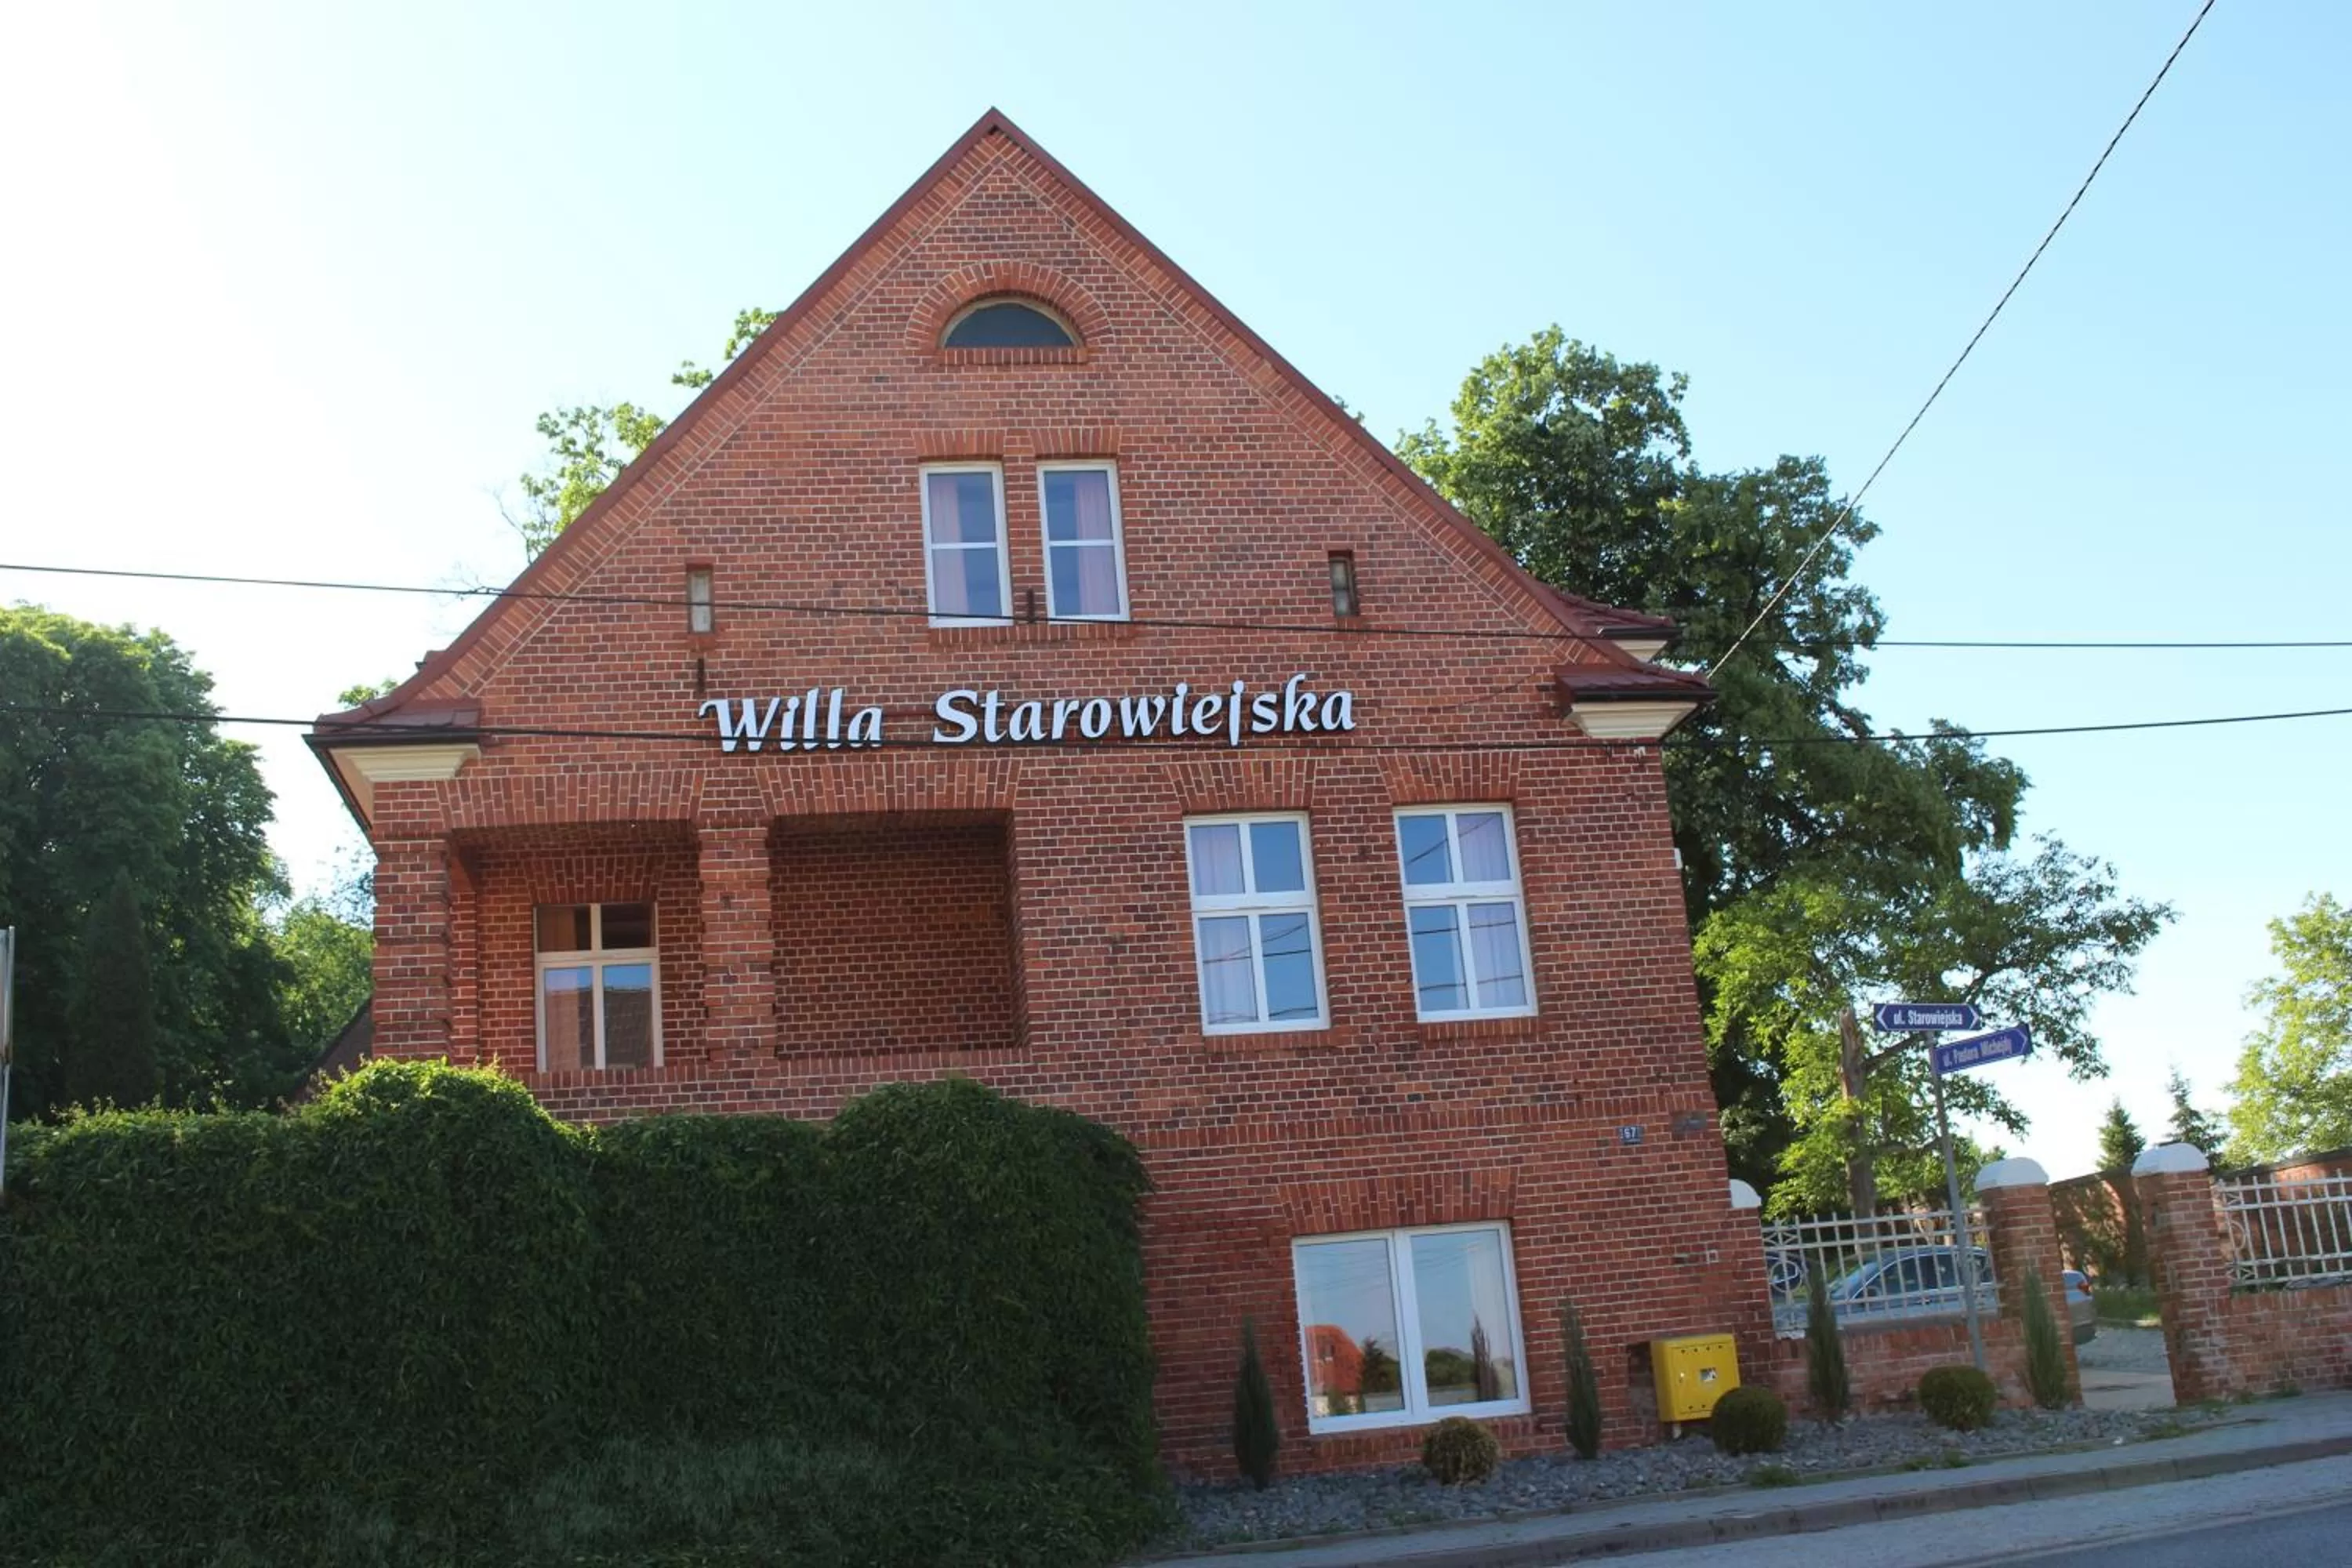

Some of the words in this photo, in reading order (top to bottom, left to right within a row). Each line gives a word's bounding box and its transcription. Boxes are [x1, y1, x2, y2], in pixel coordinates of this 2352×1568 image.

[697, 686, 884, 753] Willa
[932, 672, 1358, 747] Starowiejska
[1893, 1009, 1905, 1025] ul.
[1907, 1009, 1963, 1028] Starowiejska
